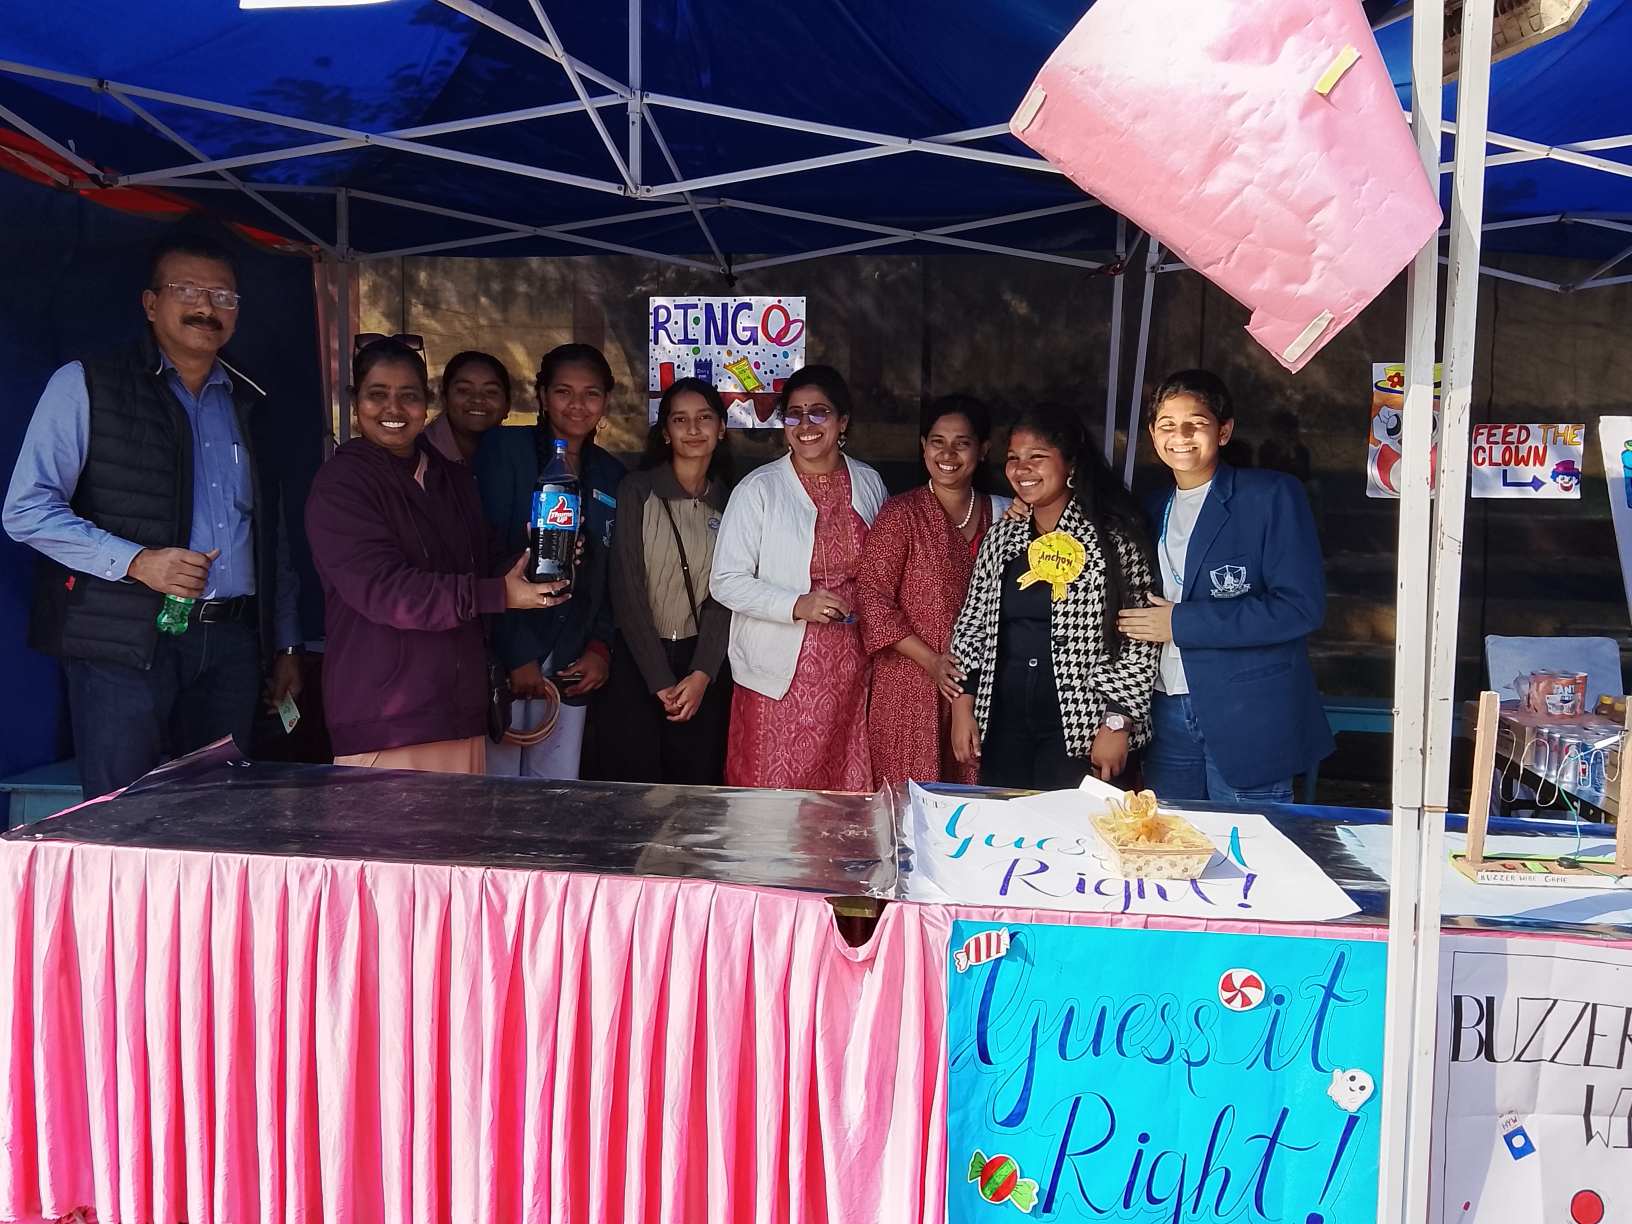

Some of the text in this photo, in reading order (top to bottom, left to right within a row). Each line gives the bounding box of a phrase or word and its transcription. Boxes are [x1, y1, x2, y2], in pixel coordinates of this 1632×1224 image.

[653, 302, 804, 346] RINGO
[1473, 424, 1582, 446] FEED THE
[1473, 446, 1547, 467] CLOWN
[951, 931, 1353, 1128] Guess it
[1042, 1091, 1361, 1224] Right!
